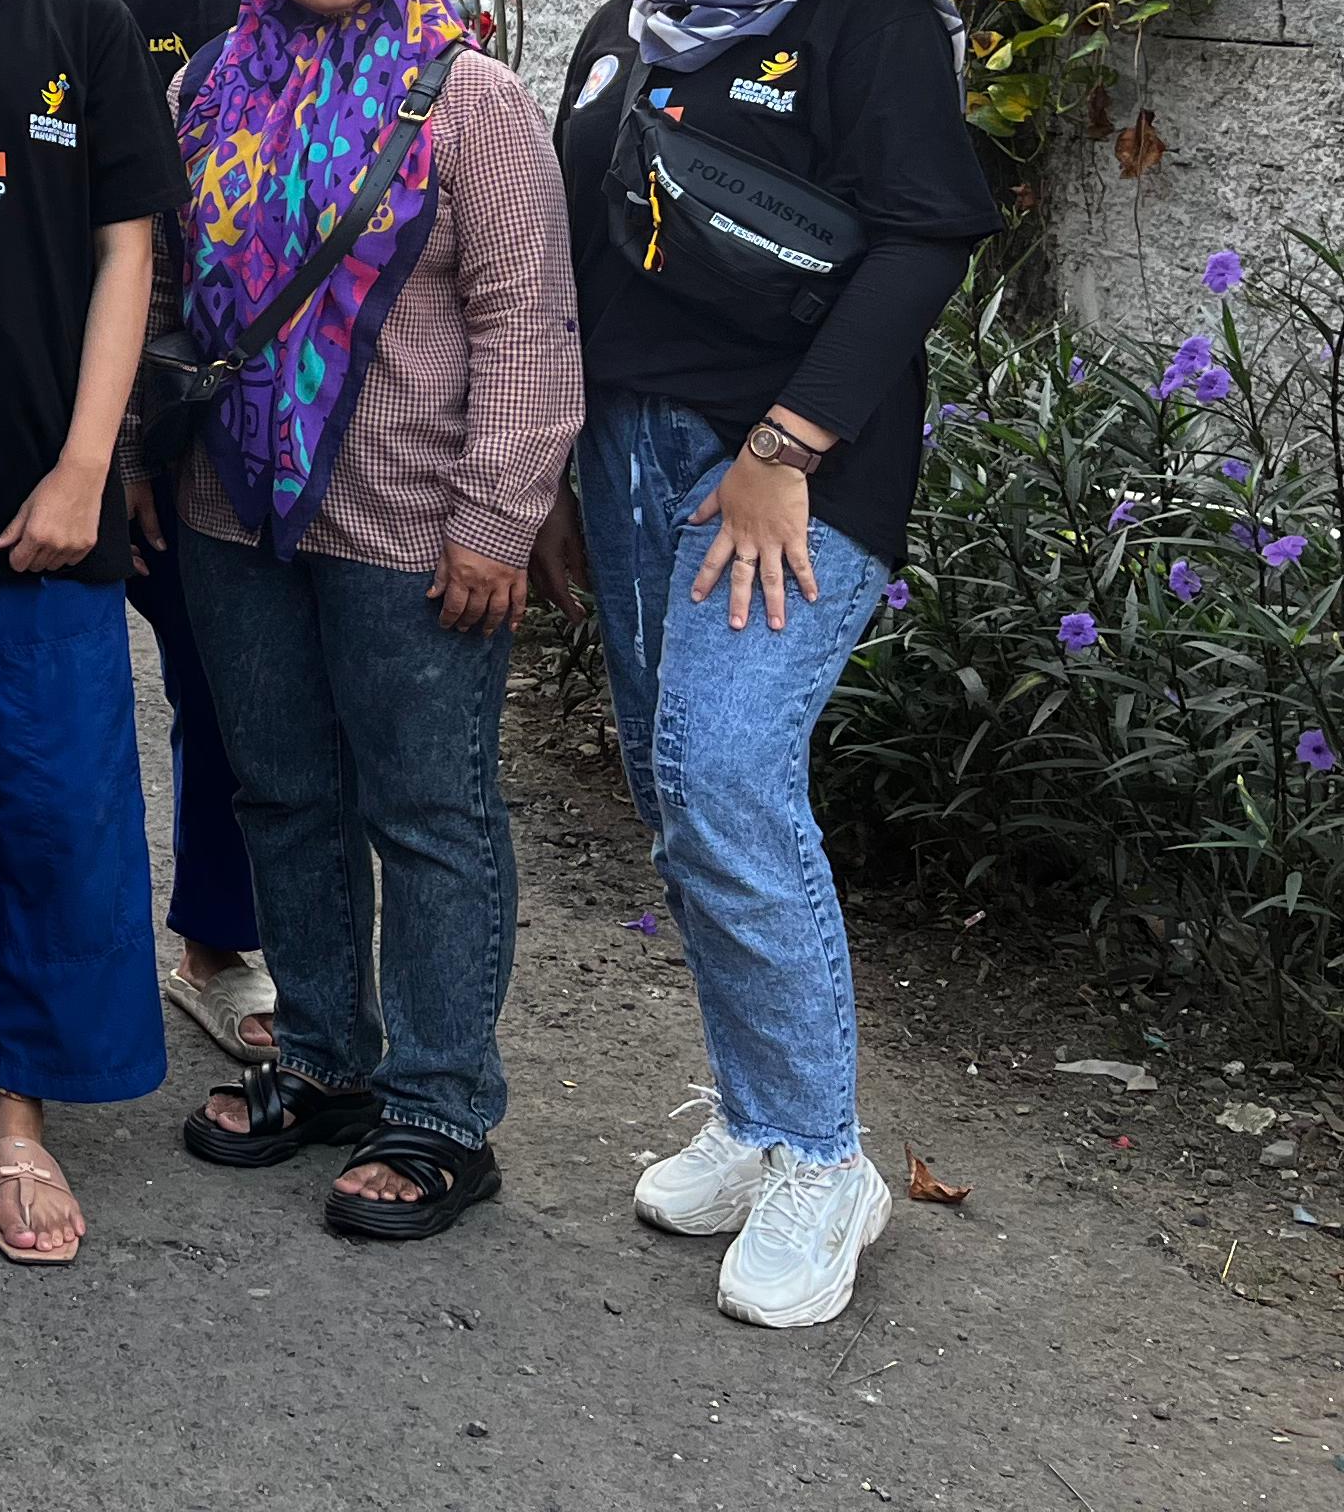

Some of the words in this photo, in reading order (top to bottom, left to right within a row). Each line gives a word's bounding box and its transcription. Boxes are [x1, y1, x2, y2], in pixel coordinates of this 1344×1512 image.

[729, 90, 765, 105] TAHUN
[732, 77, 780, 99] POPDA
[29, 113, 63, 130] POPDA
[63, 122, 77, 134] XII
[29, 128, 58, 143] TAHUN
[652, 163, 679, 195] PORT
[688, 158, 746, 195] POLO
[746, 190, 836, 246] AMSTAR
[782, 250, 831, 272] SPORT
